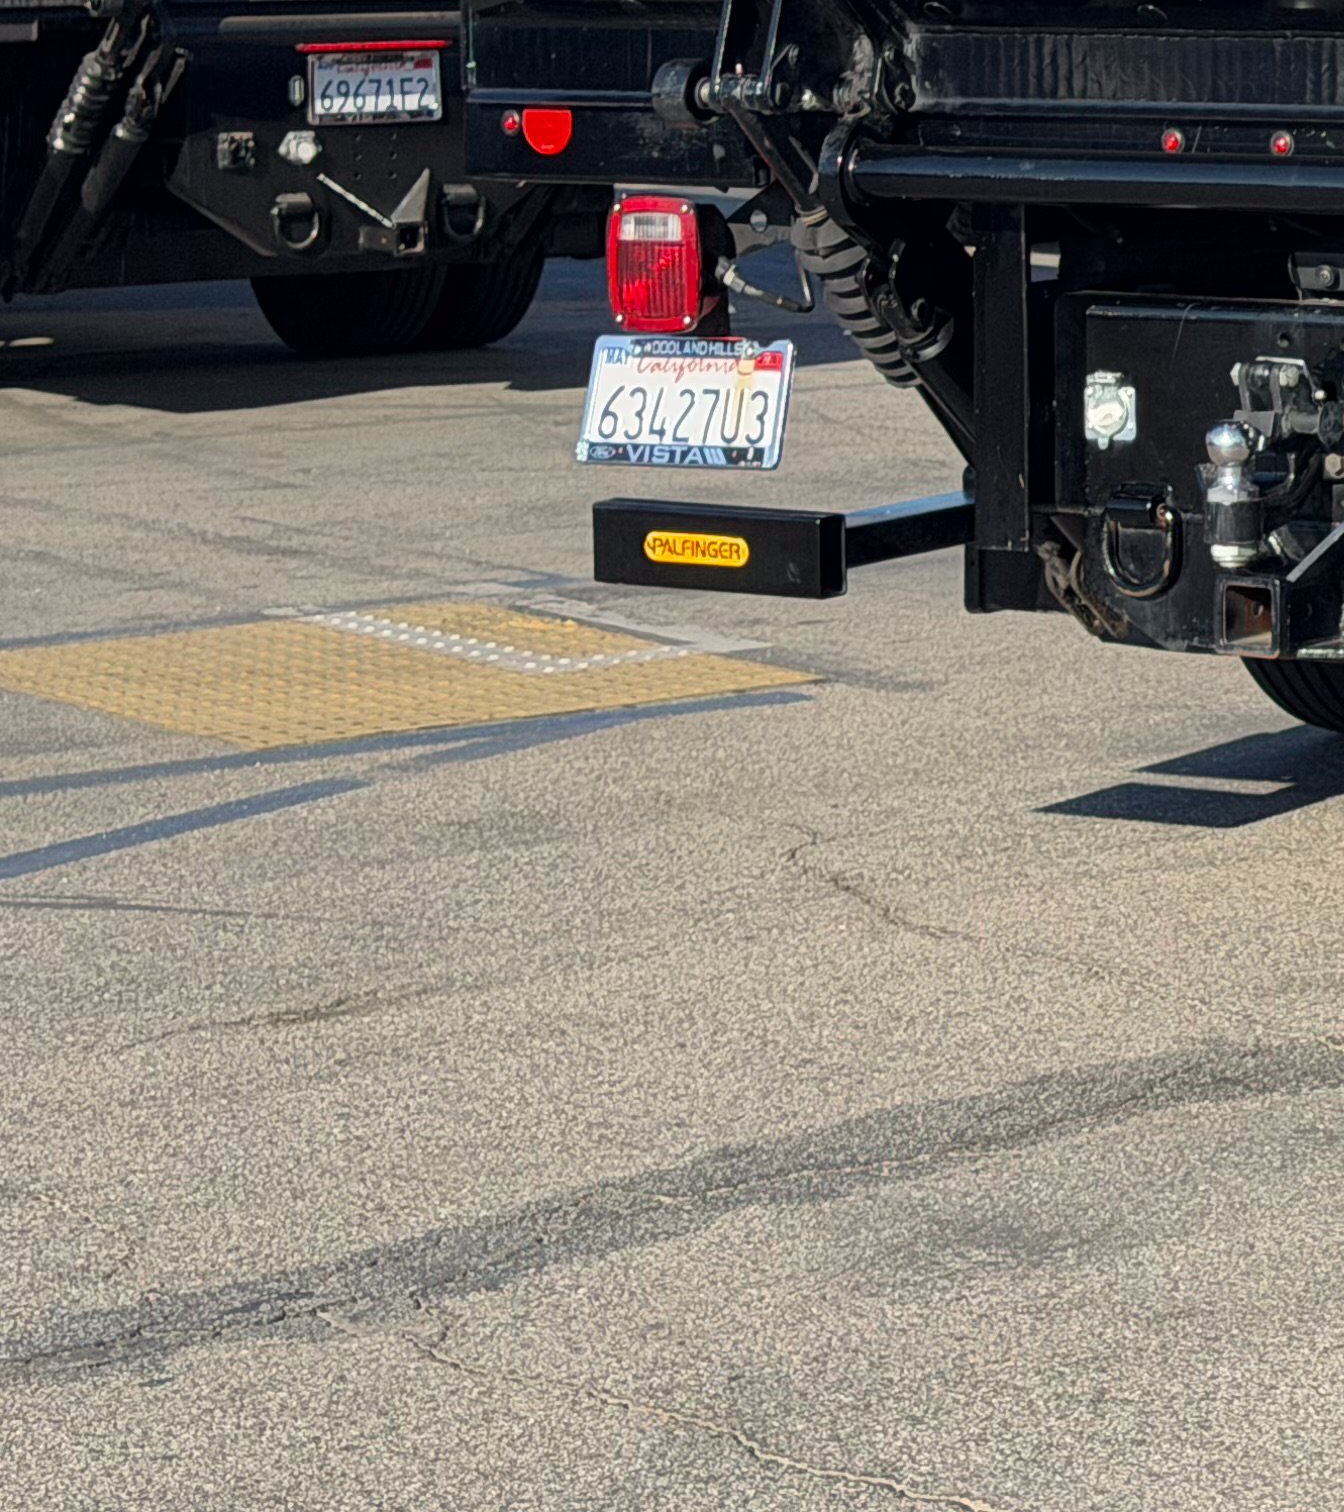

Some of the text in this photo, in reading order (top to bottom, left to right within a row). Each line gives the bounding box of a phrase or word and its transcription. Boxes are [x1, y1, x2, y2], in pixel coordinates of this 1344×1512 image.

[320, 77, 430, 113] 69671F2
[598, 385, 768, 445] 63427U3
[625, 445, 704, 465] VISTA
[650, 537, 742, 561] PALFINGER
